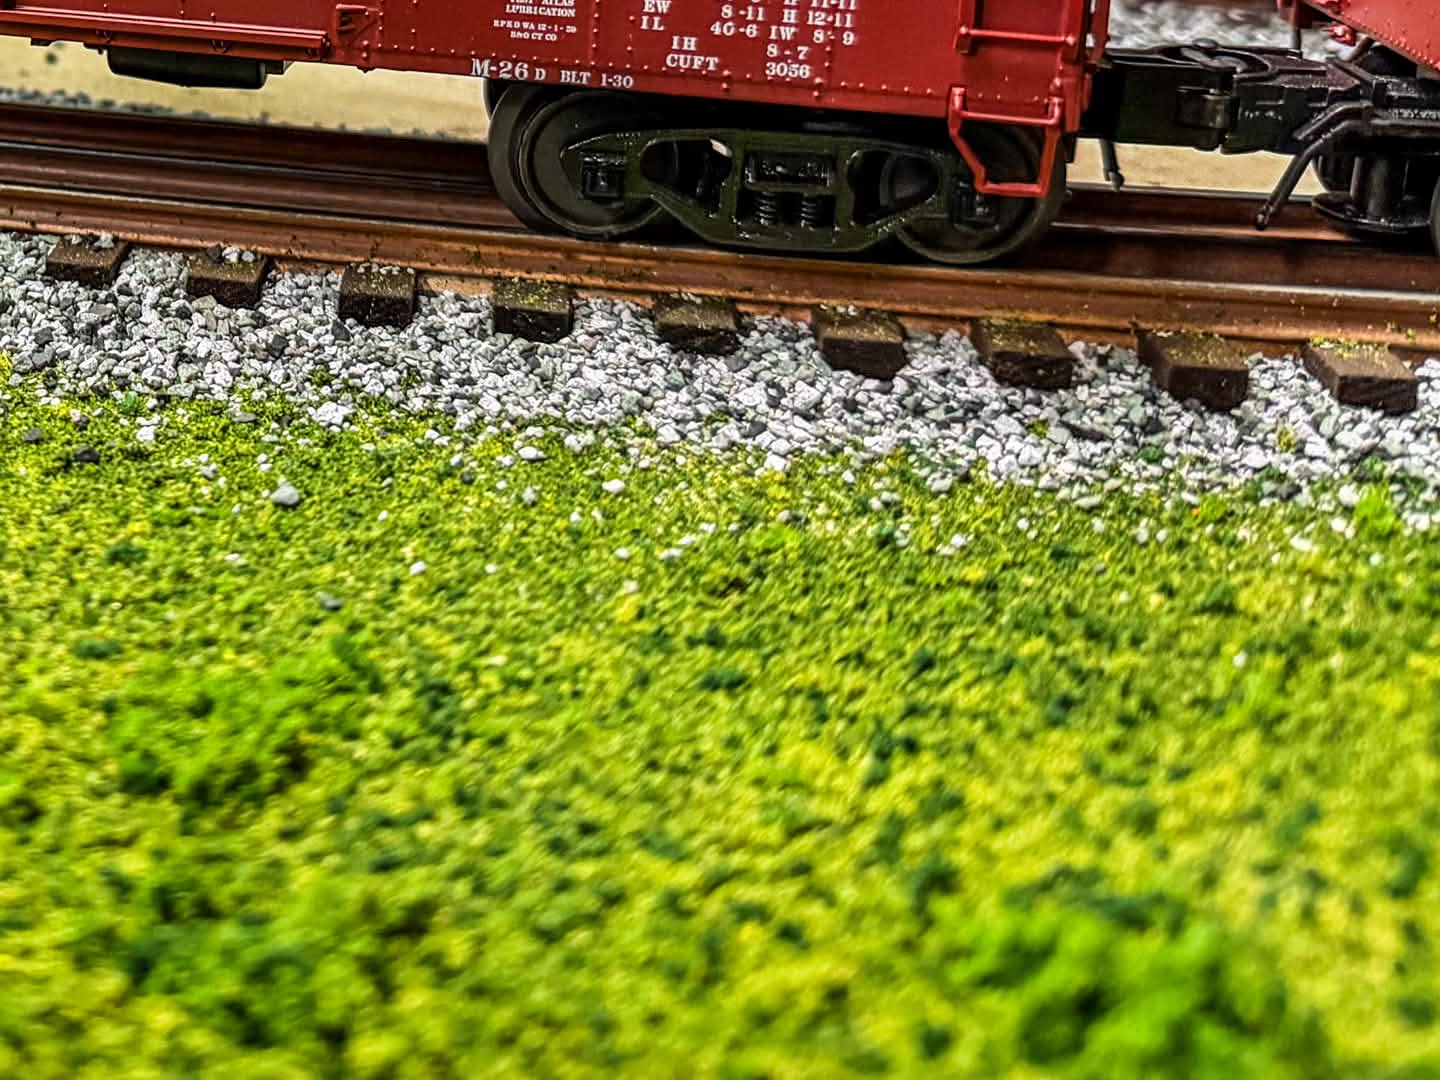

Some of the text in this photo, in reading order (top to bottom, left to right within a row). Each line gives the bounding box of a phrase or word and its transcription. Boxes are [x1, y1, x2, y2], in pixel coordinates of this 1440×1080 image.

[505, 4, 576, 17] LUBRICATION
[782, 8, 798, 24] H
[807, 10, 854, 28] 12-11
[768, 25, 797, 41] IW
[671, 35, 698, 51] IH
[471, 57, 634, 89] M-26 D BLT 1-30
[765, 61, 811, 79] 3056
